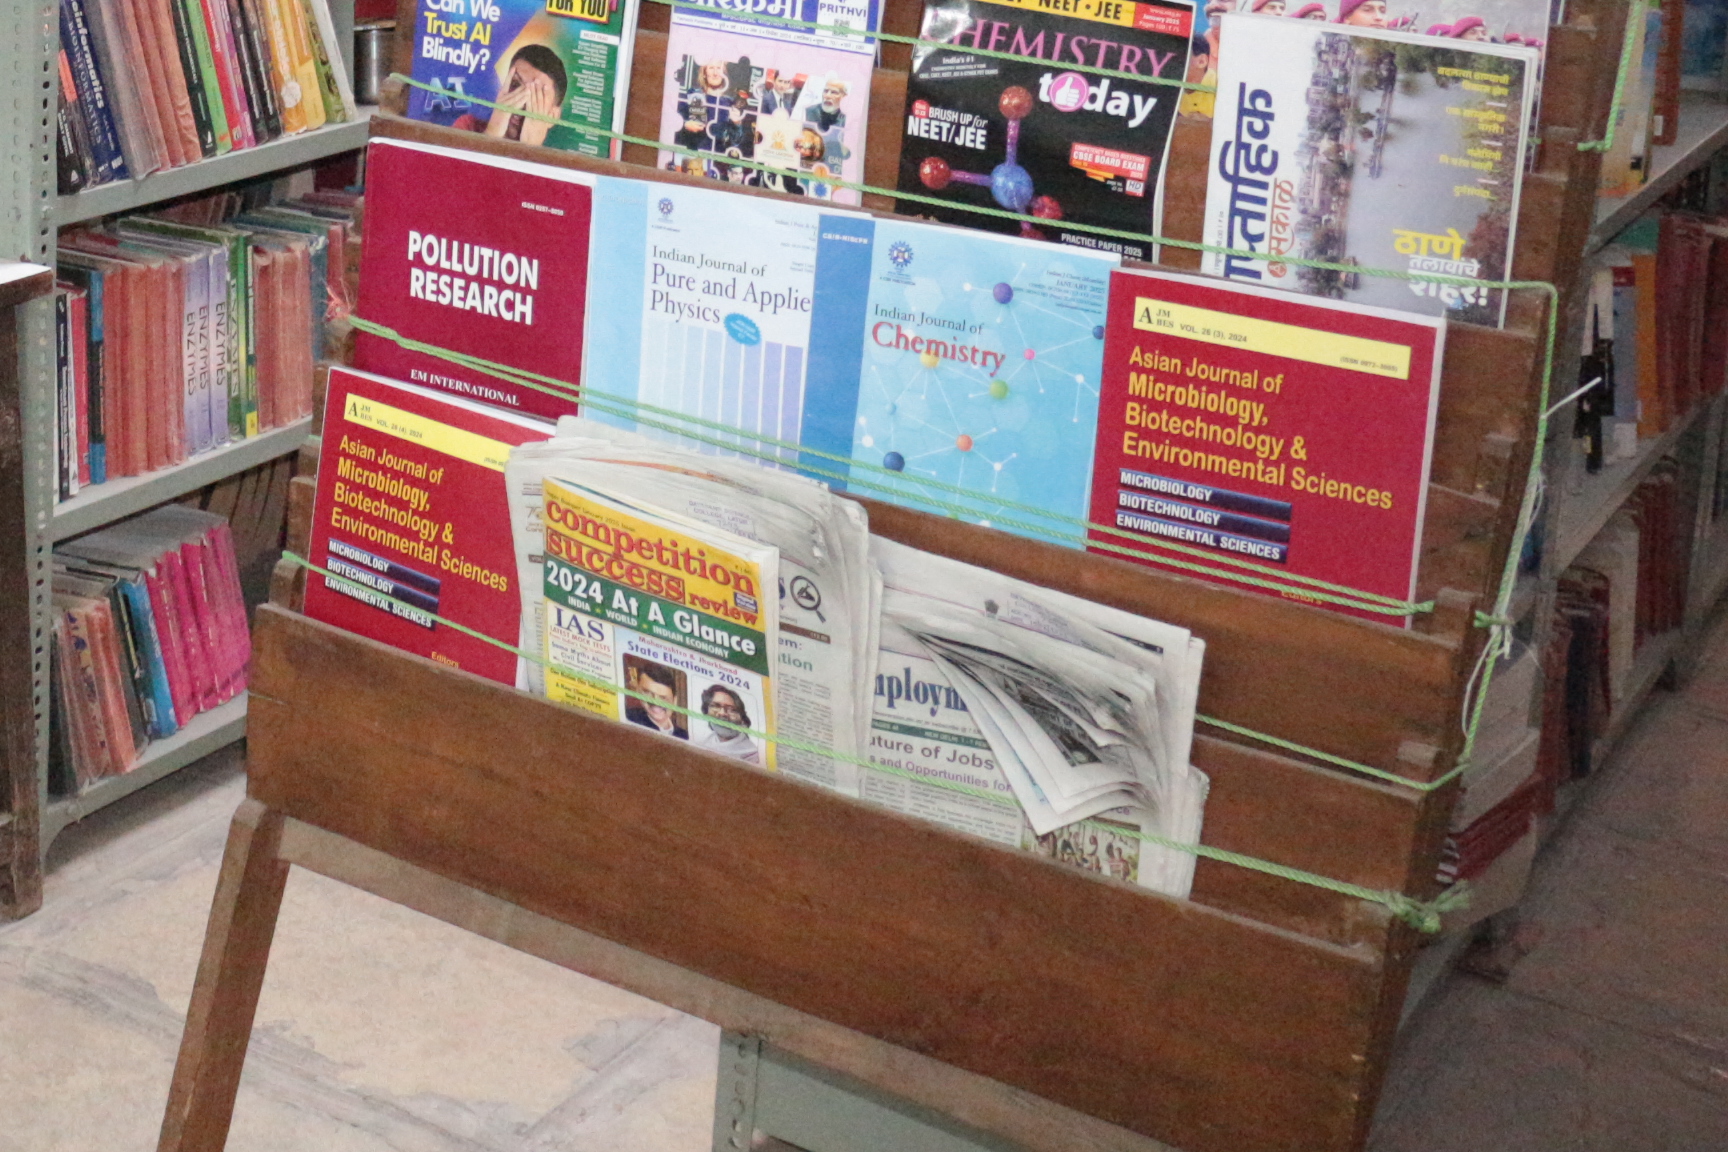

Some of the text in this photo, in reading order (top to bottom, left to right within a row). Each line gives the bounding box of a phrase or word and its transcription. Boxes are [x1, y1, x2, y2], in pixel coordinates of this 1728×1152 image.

[423, 11, 492, 44] Trust AI
[421, 36, 491, 74] Blindly?
[906, 116, 988, 150] NEET/JEE
[407, 229, 539, 290] POLLUTION
[651, 245, 769, 278] Indian Journal of
[1061, 232, 1143, 258] PRACTICE PAPER 2025
[1392, 227, 1468, 261] ठाणे
[409, 267, 534, 326] RESEARCH
[649, 289, 722, 326] Physics
[651, 262, 813, 316] Pure and Applie
[186, 311, 197, 397] ENZYMES
[198, 305, 209, 390] ENZYMES
[215, 301, 226, 386] ENZYMES
[871, 320, 1007, 378] Chemistry
[410, 368, 521, 407] EM INTERNATIONAL
[1129, 345, 1285, 395] Asian Journal of
[1128, 371, 1271, 426] Microbiology,
[1125, 401, 1308, 462] Biotechnology &
[336, 456, 431, 512] Microbiology,
[339, 434, 445, 486] Asian Journal of
[1122, 431, 1394, 510] Environmental Sciences
[1118, 492, 1221, 528] BIOTECHNOLOGY
[1120, 470, 1213, 503] MICROBIOLOGY
[333, 481, 455, 545] Biotechnology &
[1116, 513, 1281, 561] ENVIRONMENTAL SCIENCES
[328, 539, 390, 573] MICROBIOLOGY
[331, 506, 509, 593] Environmental Sciences
[546, 499, 756, 598] competition
[324, 577, 432, 629] ENVIRONMENTAL SCIENCES
[326, 559, 394, 595] BIOTECHNOLOGY
[547, 531, 759, 627] success review
[546, 559, 757, 657] 2024 At A Glance
[554, 607, 605, 642] IAS
[879, 756, 902, 770] and
[905, 760, 989, 789] Opportunities
[920, 745, 995, 771] of Jobs
